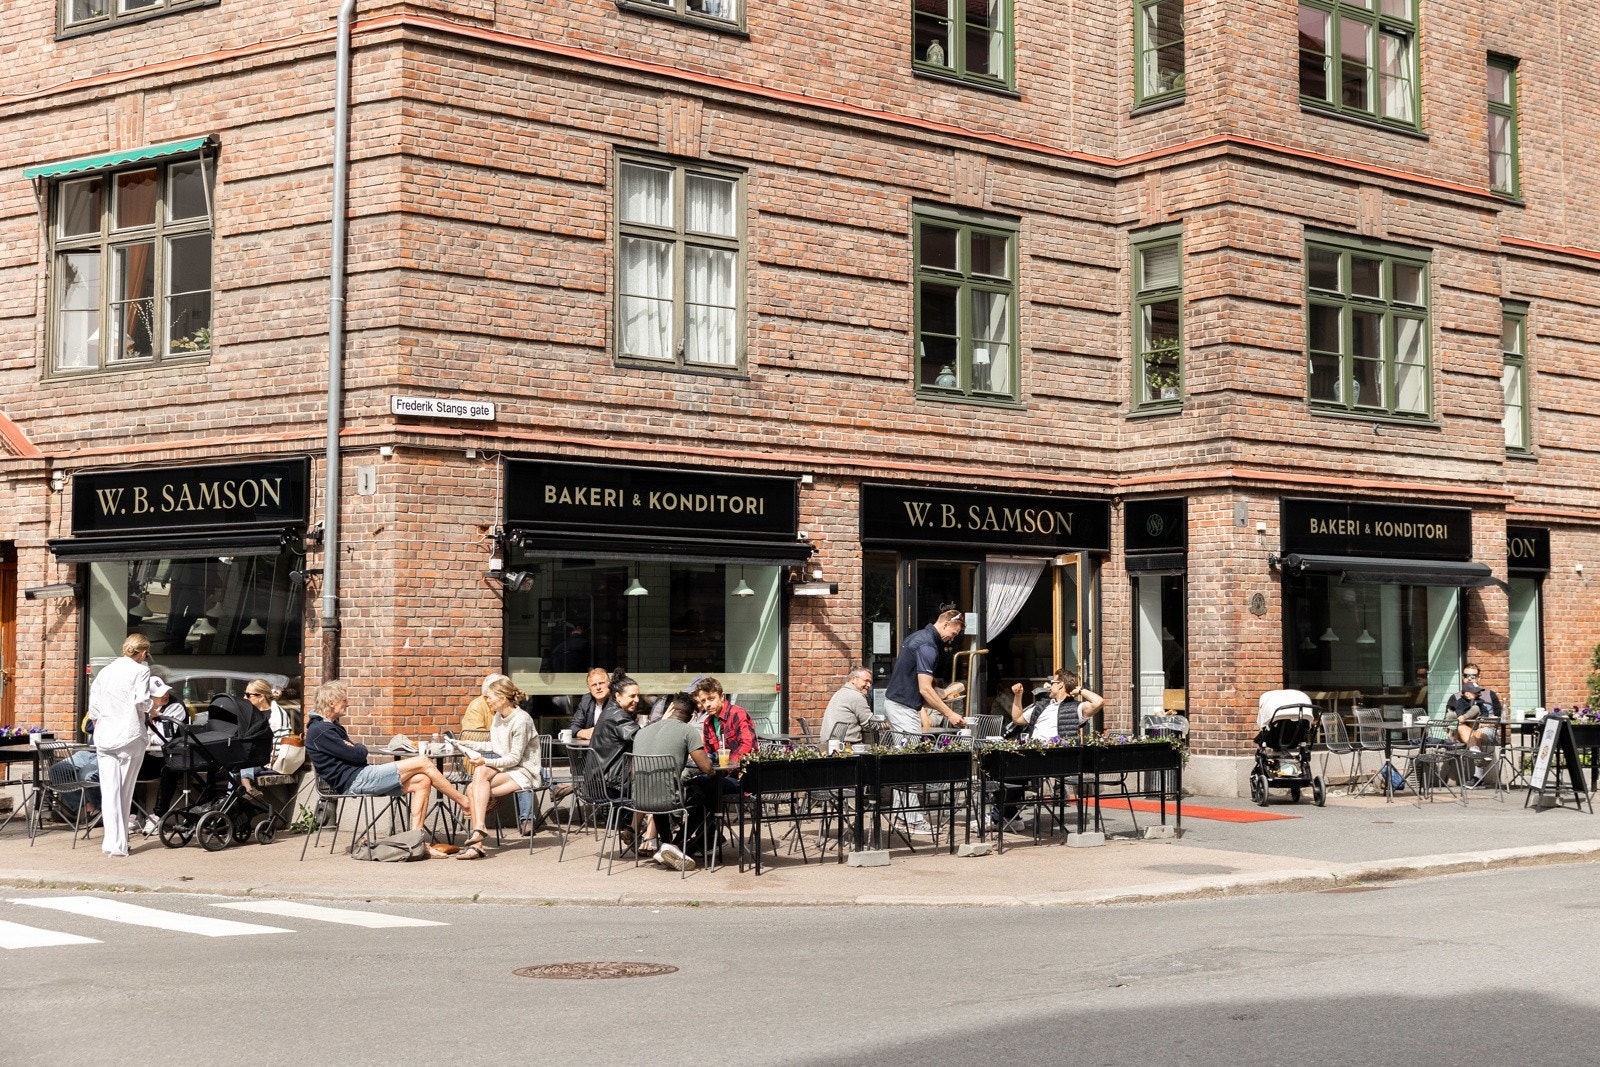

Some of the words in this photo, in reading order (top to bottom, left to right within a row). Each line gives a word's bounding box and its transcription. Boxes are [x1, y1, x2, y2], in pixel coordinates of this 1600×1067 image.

[396, 399, 433, 412] Frederik
[436, 402, 468, 415] Stangs
[470, 405, 490, 416] gate
[96, 487, 126, 516] W.
[133, 486, 155, 514] B.
[161, 477, 282, 512] SAMSON
[544, 484, 624, 507] BAKERI
[632, 493, 642, 506] &
[649, 491, 764, 515] KONDITORI
[903, 501, 934, 527] W.
[941, 503, 962, 529] B.
[968, 505, 1073, 535] SAMSON
[1310, 518, 1360, 536] BAKERI
[1364, 523, 1371, 534] &
[1375, 521, 1448, 540] KONDITORI
